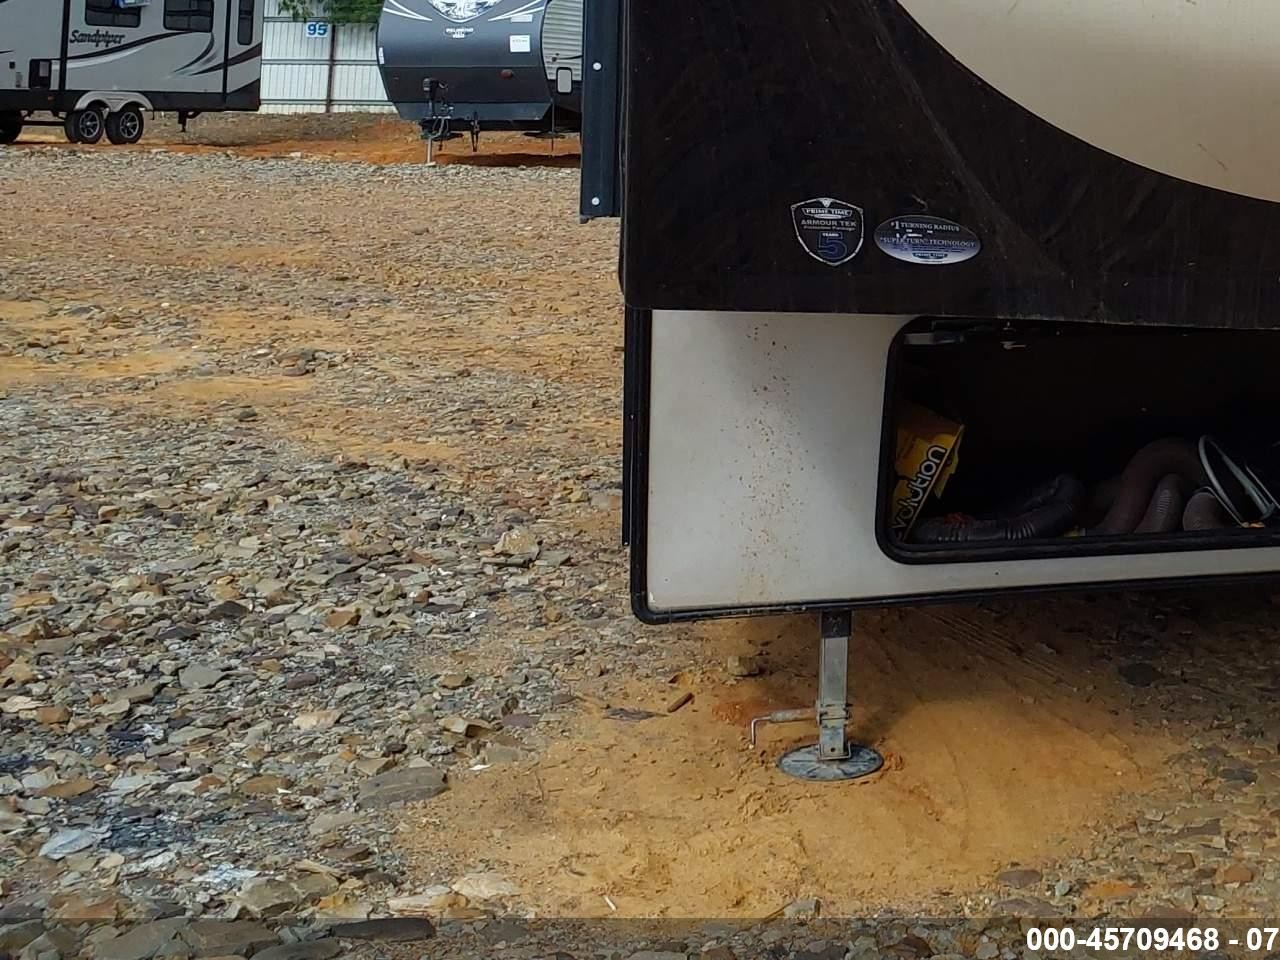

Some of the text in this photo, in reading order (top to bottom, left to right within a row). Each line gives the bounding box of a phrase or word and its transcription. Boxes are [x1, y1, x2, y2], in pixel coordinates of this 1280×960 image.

[307, 22, 328, 36] 95
[69, 29, 126, 48] Sandpiper
[900, 222, 933, 230] TURNING
[933, 223, 960, 232] RADIUS
[817, 230, 848, 260] 5
[929, 238, 977, 248] TECHNOLOGY
